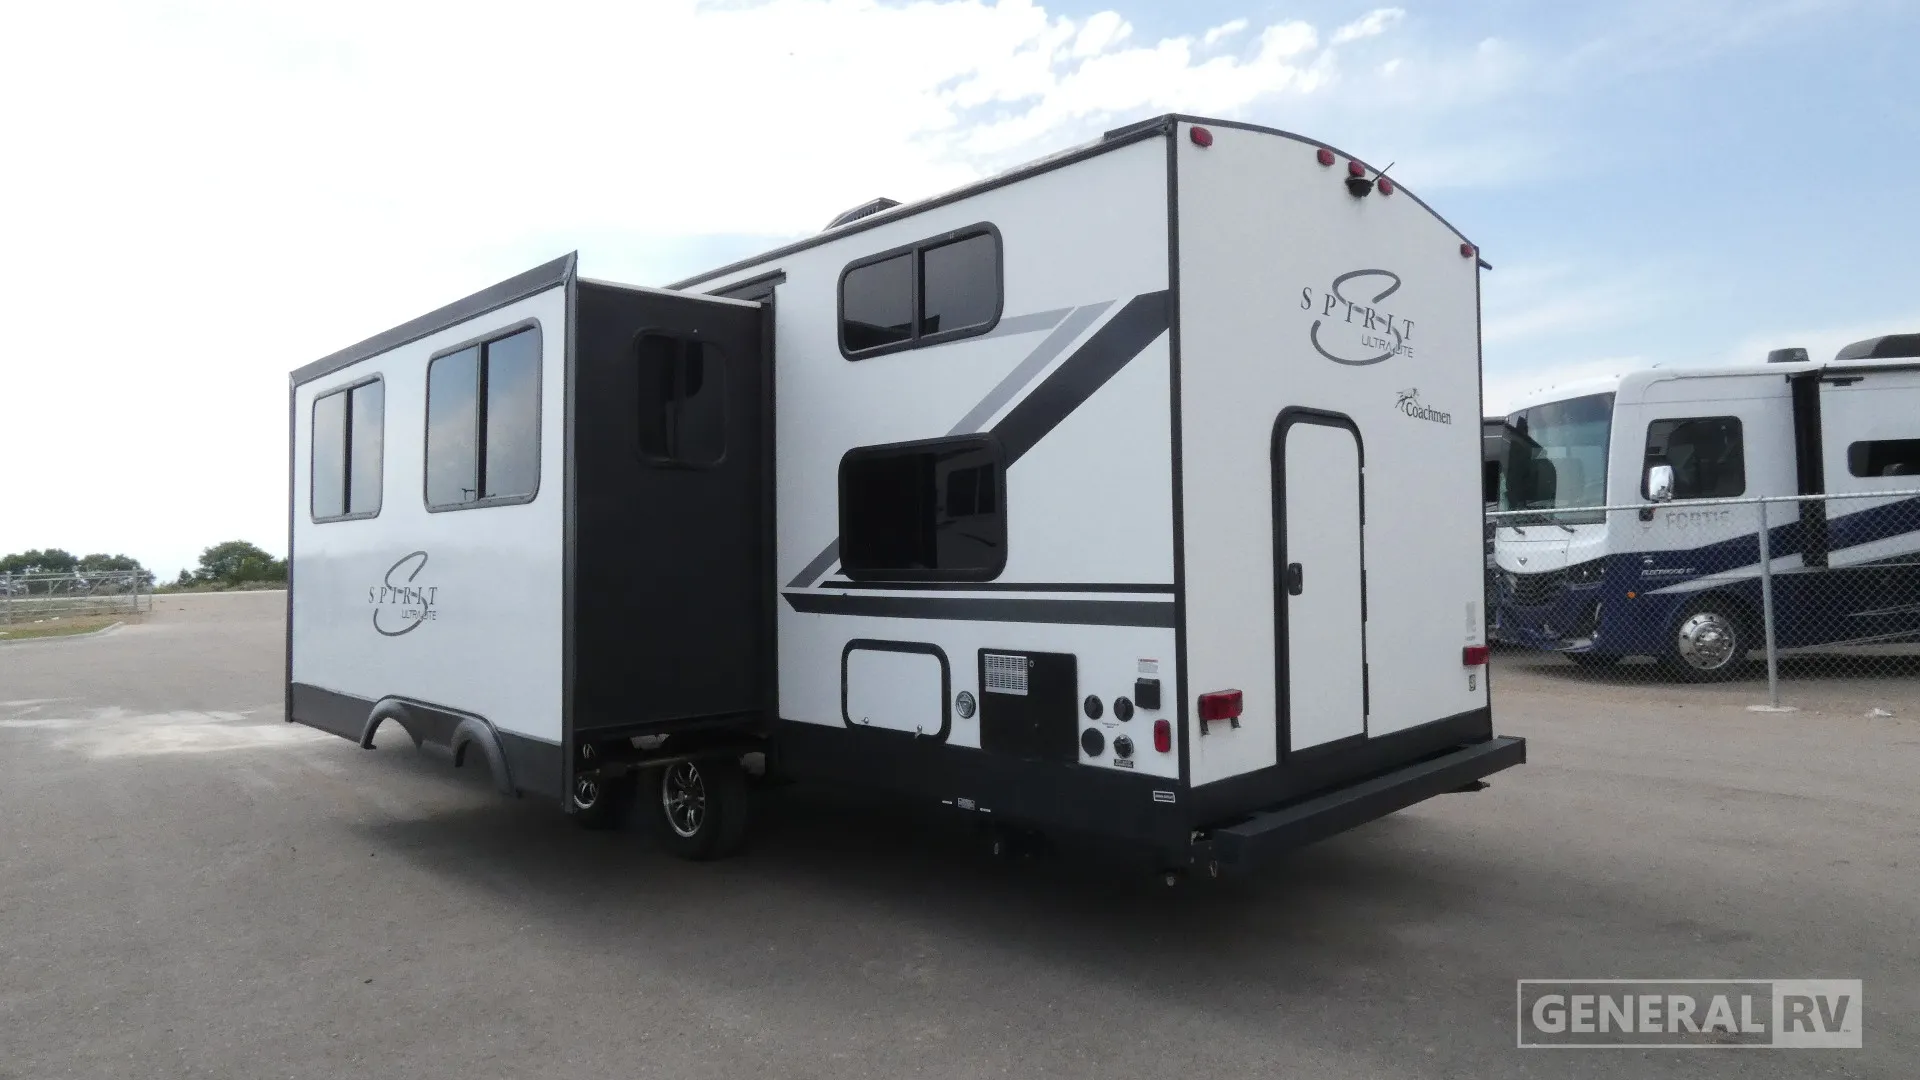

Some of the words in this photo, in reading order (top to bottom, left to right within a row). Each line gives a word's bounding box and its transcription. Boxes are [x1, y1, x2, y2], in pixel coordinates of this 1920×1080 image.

[1300, 286, 1415, 341] SPIRIT
[1406, 401, 1451, 425] Coachmen
[368, 586, 438, 606] SPIRIT
